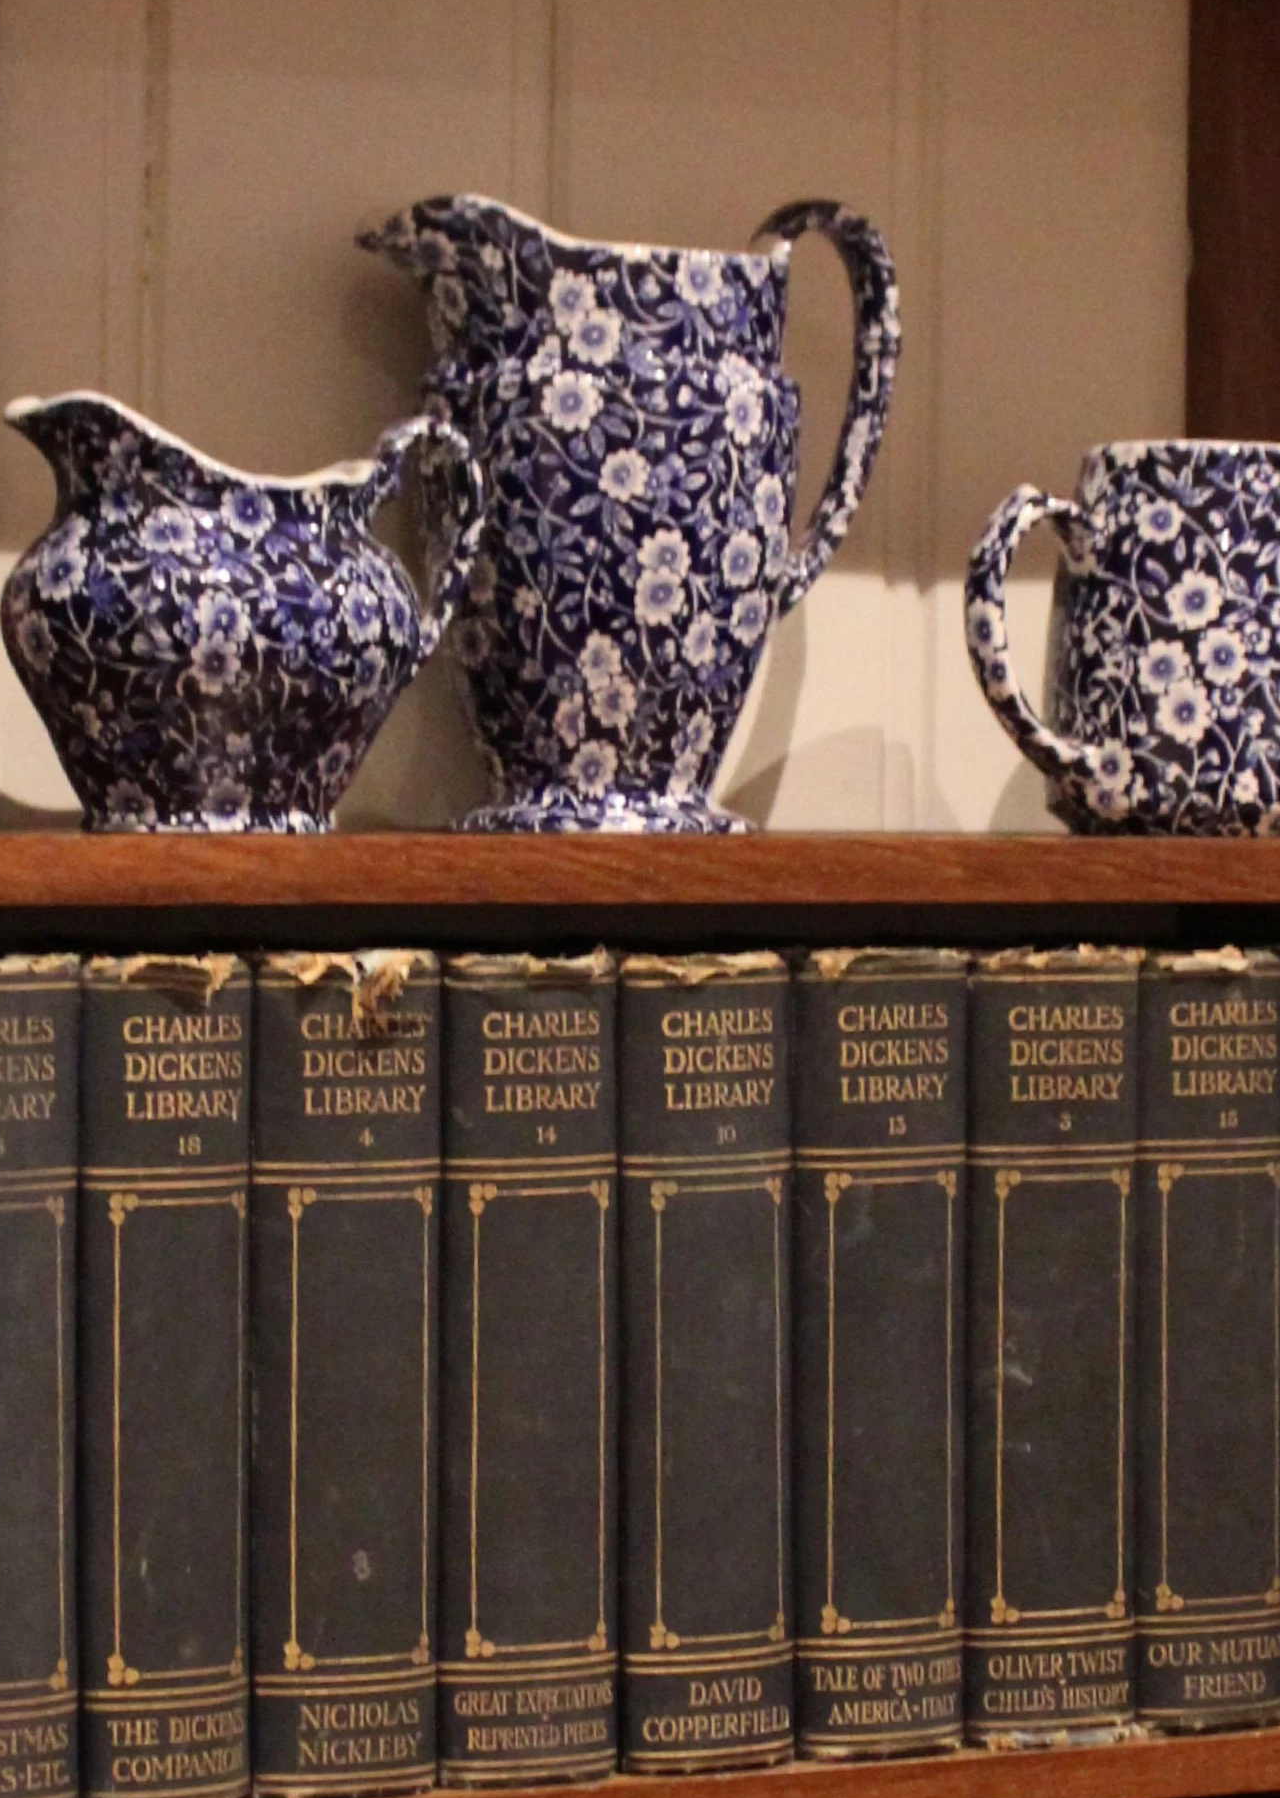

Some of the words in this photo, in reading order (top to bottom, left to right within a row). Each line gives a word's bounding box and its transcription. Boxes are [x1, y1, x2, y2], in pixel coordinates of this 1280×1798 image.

[122, 1013, 243, 1044] CHARLES
[482, 1010, 600, 1040] CHARLES
[661, 1008, 774, 1038] CHARLES
[837, 1003, 949, 1033] CHARLES
[1008, 1005, 1124, 1032] CHARLES
[1169, 999, 1278, 1027] CHARLES
[302, 1047, 426, 1078] DICKENS
[483, 1044, 601, 1076] DICKENS
[663, 1043, 775, 1075] DICKENS
[839, 1038, 949, 1069] DICKENS
[1009, 1037, 1124, 1066] DICKENS
[1170, 1033, 1278, 1062] DICKENS
[124, 1048, 243, 1082] DICKENS
[484, 1081, 602, 1113] LIBRARY
[663, 1077, 776, 1111] LIBRARY
[840, 1073, 950, 1104] LIBRARY
[1010, 1072, 1125, 1102] LIBRARY
[1172, 1067, 1278, 1098] LIBRARY
[124, 1087, 243, 1120] LIBRARY
[303, 1084, 427, 1116] LIBRARY
[535, 1124, 558, 1145] 14
[716, 1124, 737, 1145] 10
[887, 1115, 907, 1136] 13
[1059, 1111, 1072, 1131] 3
[177, 1135, 202, 1156] 18
[358, 1128, 375, 1147] 4
[986, 1653, 1062, 1681] OLIVER
[1066, 1647, 1128, 1677] TWIST
[1147, 1641, 1203, 1668] OUR
[688, 1675, 764, 1708] DAVID
[811, 1664, 859, 1692] TALE
[862, 1662, 886, 1690] OF
[890, 1660, 925, 1689] TWO
[1183, 1670, 1268, 1701] FRIEND
[453, 1687, 513, 1718] GREAT
[515, 1679, 615, 1714] EXPECTATIONS
[828, 1697, 912, 1726] AMERICA
[983, 1684, 1056, 1714] CHILD'S
[1061, 1680, 1129, 1710] HISTORY
[106, 1717, 160, 1748] THE
[169, 1707, 246, 1745] DICKENS
[298, 1697, 421, 1732] NICHOLAS
[641, 1704, 791, 1743] COPPERFIELD
[297, 1730, 424, 1768] NICKLEBY
[466, 1723, 560, 1751] REPRINTED
